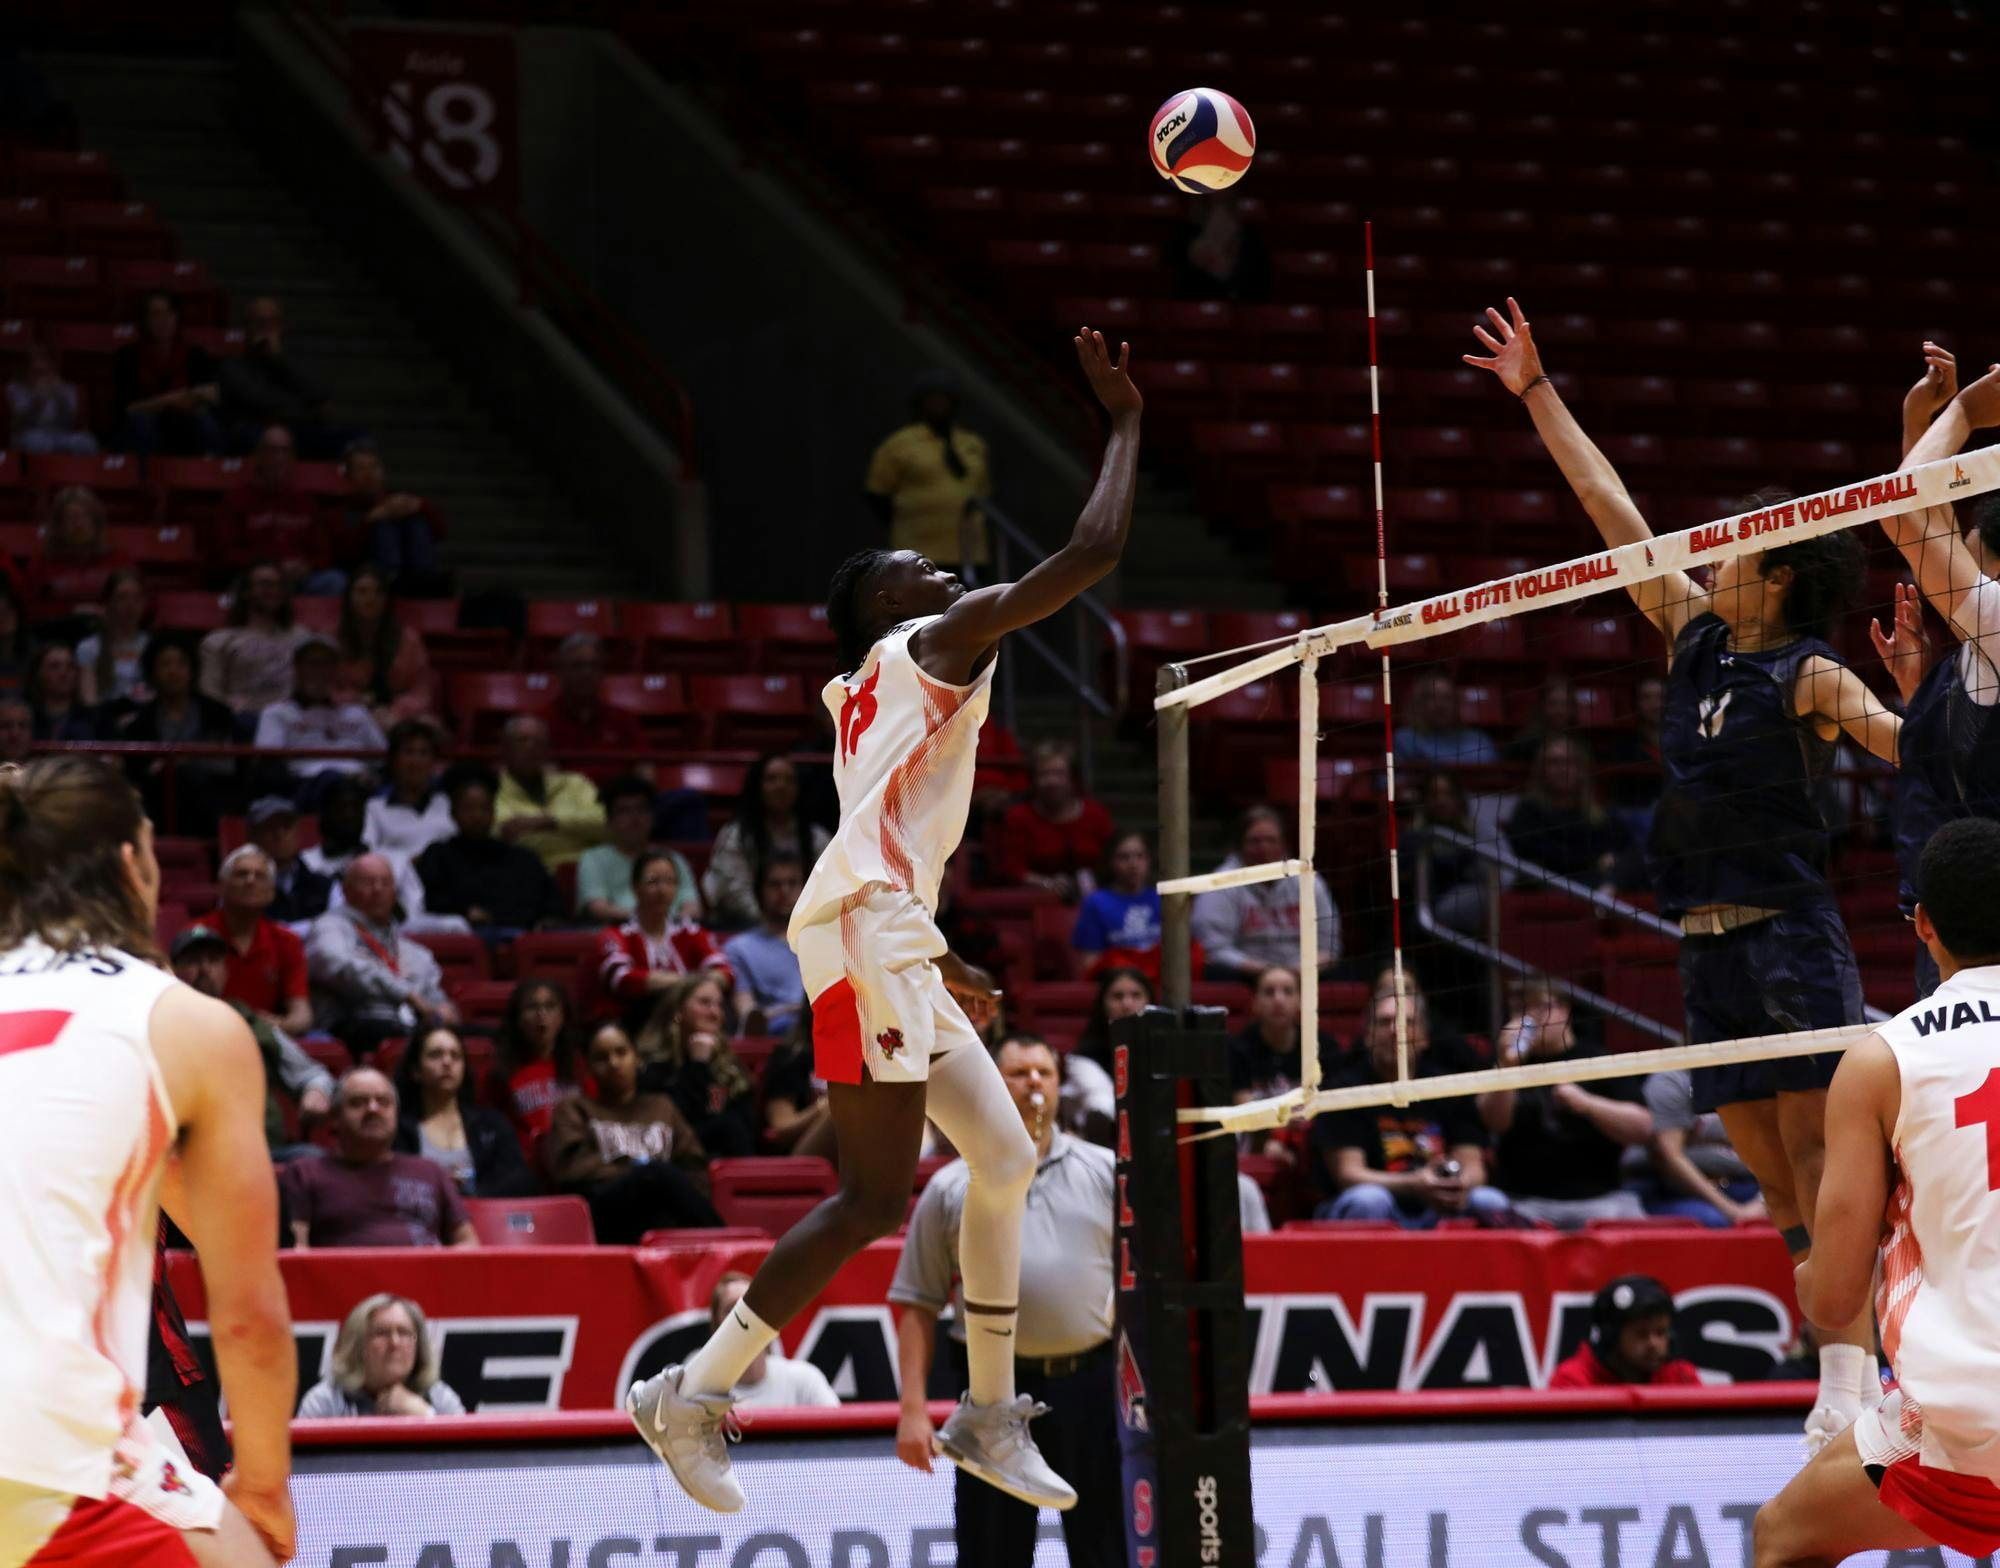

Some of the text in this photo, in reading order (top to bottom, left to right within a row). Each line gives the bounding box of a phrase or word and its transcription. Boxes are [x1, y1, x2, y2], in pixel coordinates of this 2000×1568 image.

[1156, 112, 1187, 142] NCAA
[1689, 474, 1917, 553] BALL STATE VOLLEYBALL
[1421, 556, 1618, 624] BALL STATE VOLLEYBALL
[1910, 999, 2000, 1038] WAL
[1114, 1044, 1137, 1292] BALL
[1194, 1476, 1222, 1562] sports
